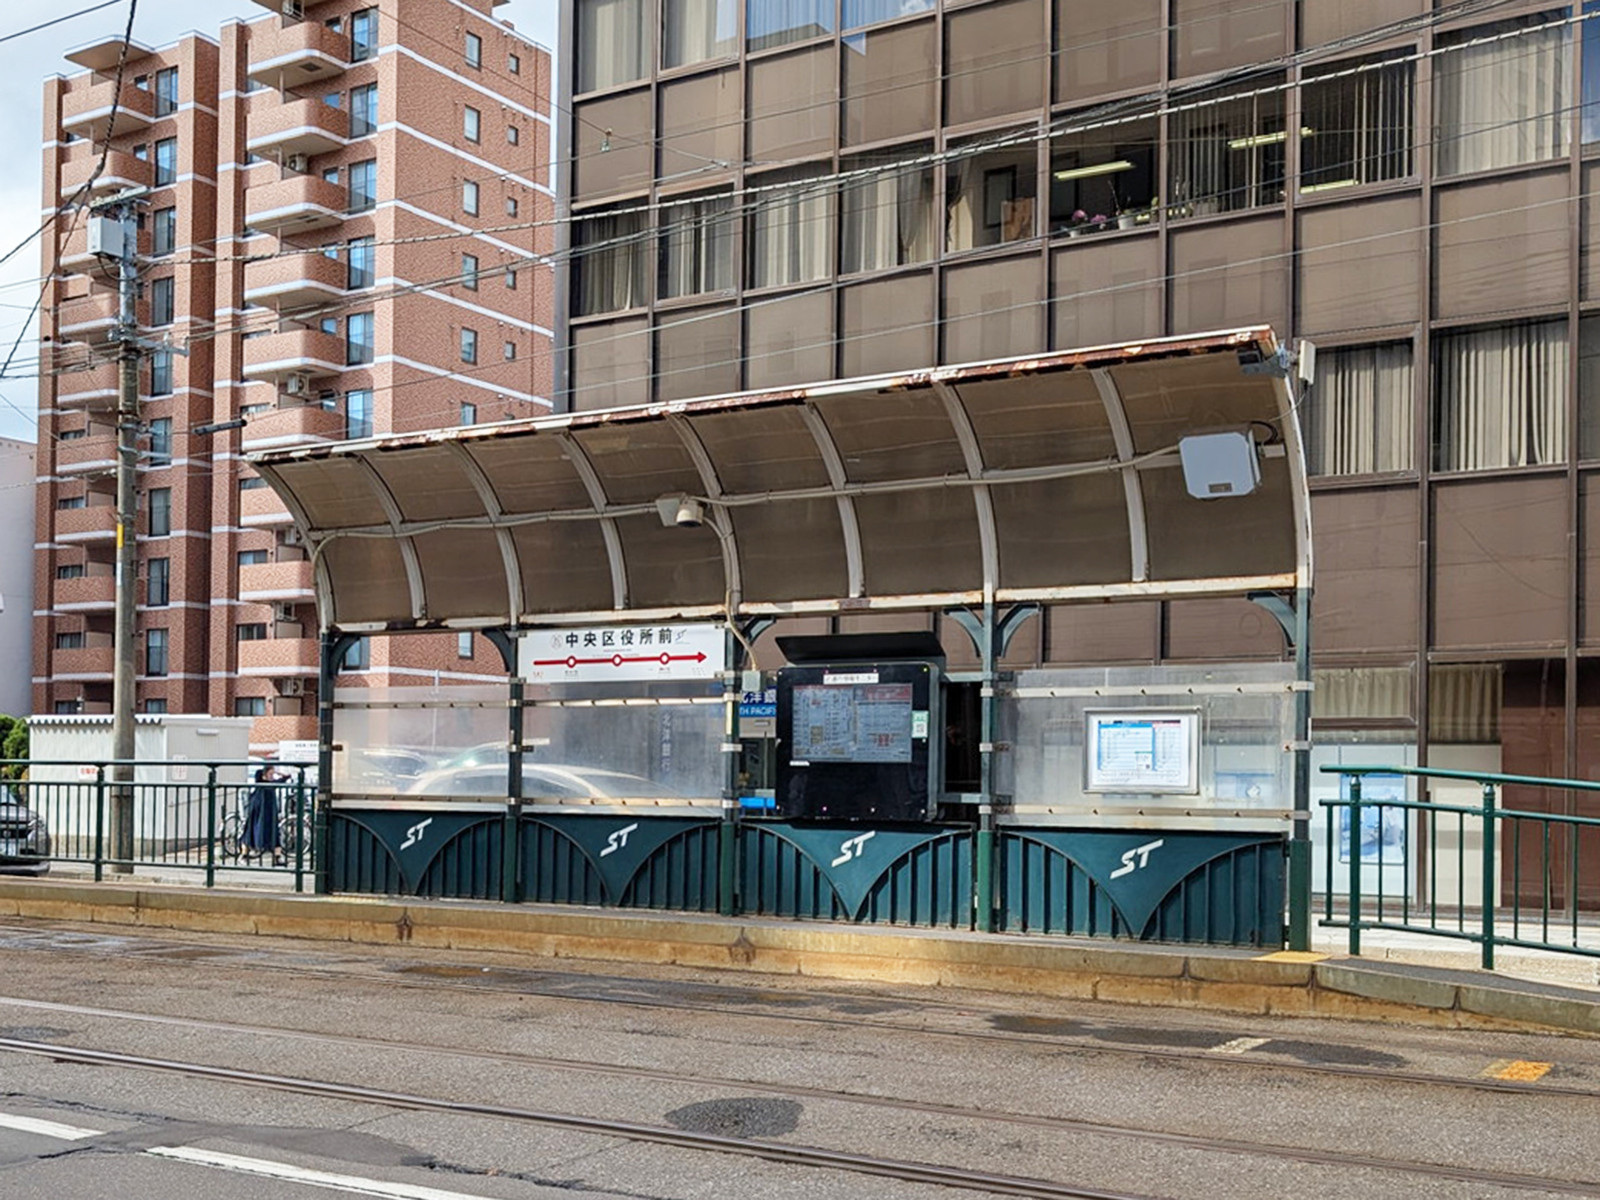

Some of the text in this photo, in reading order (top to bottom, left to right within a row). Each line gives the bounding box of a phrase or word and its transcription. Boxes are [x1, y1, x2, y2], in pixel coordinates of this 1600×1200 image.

[565, 627, 672, 648] 中央区役所前
[400, 818, 433, 850] ST
[600, 823, 638, 857] ST
[831, 830, 876, 868] ST
[1109, 838, 1164, 880] ST
